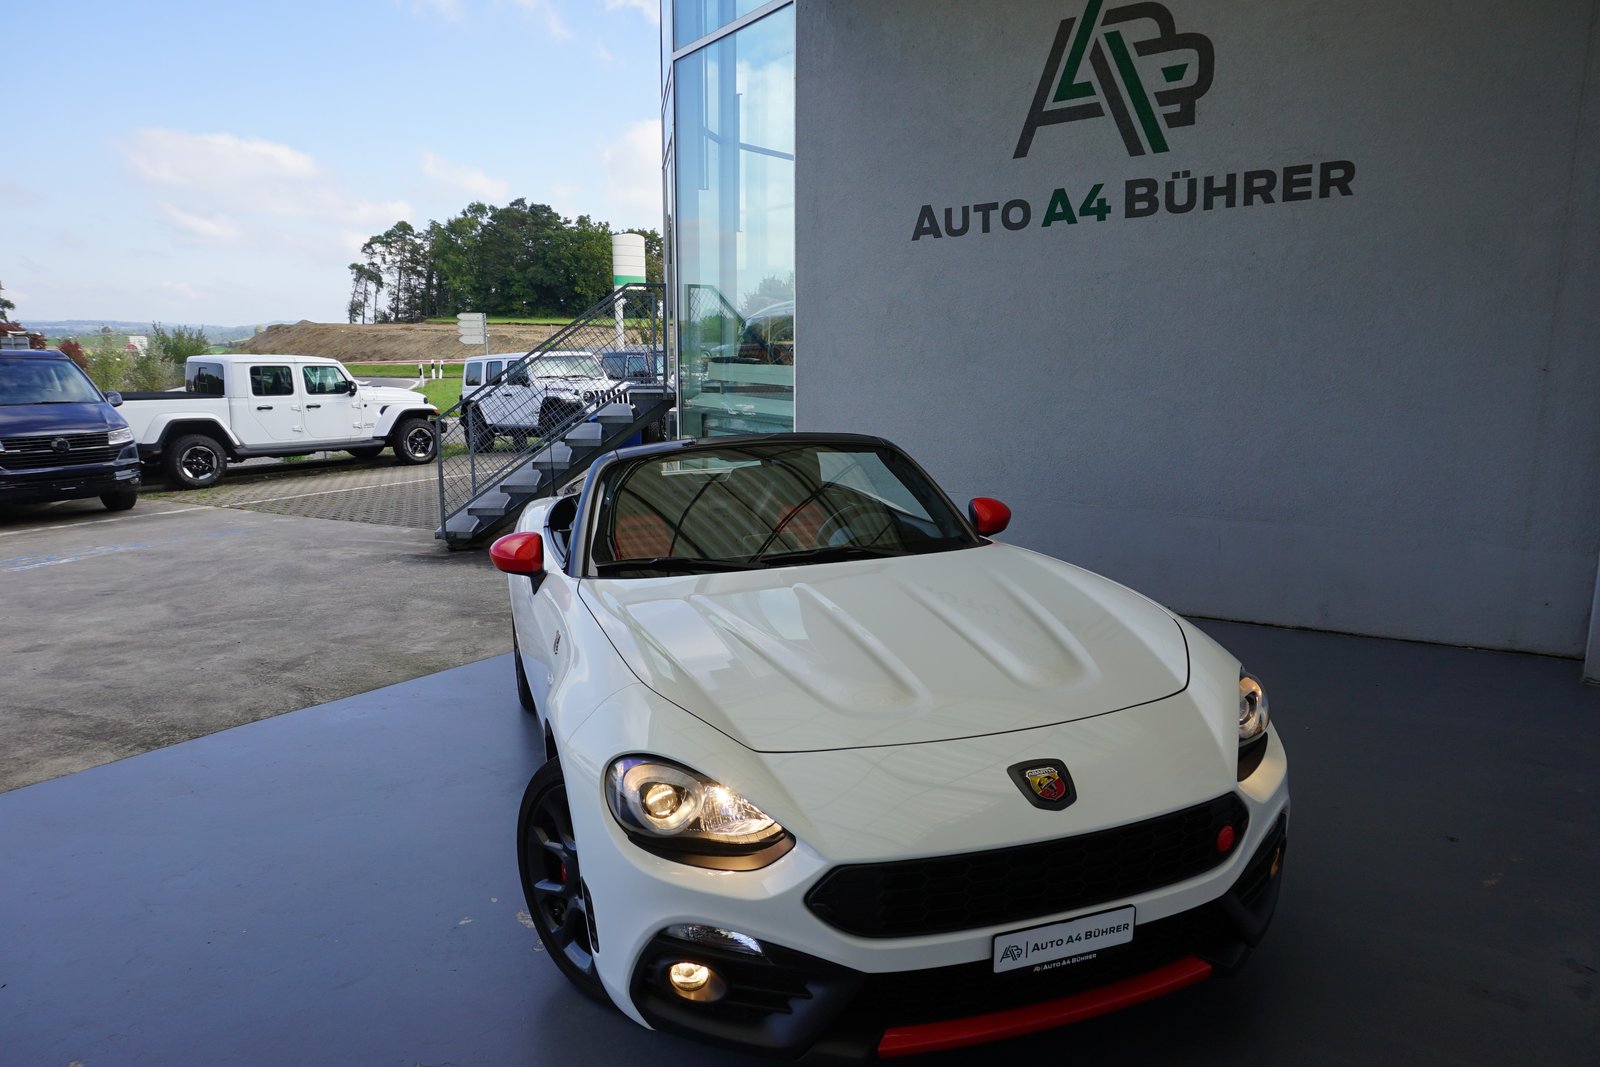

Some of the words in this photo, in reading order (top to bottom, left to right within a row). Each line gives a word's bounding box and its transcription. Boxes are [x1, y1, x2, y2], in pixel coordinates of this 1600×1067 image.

[911, 199, 1032, 242] AUTO
[1041, 183, 1112, 228] A4
[1124, 160, 1356, 219] BÜHRER
[1031, 938, 1064, 952] AUTO
[1065, 933, 1083, 945] A4
[1084, 923, 1130, 940] BÜHRER
[1043, 961, 1061, 971] AUTO
[1061, 958, 1071, 966] A4
[1071, 953, 1097, 964] BÜHRER
